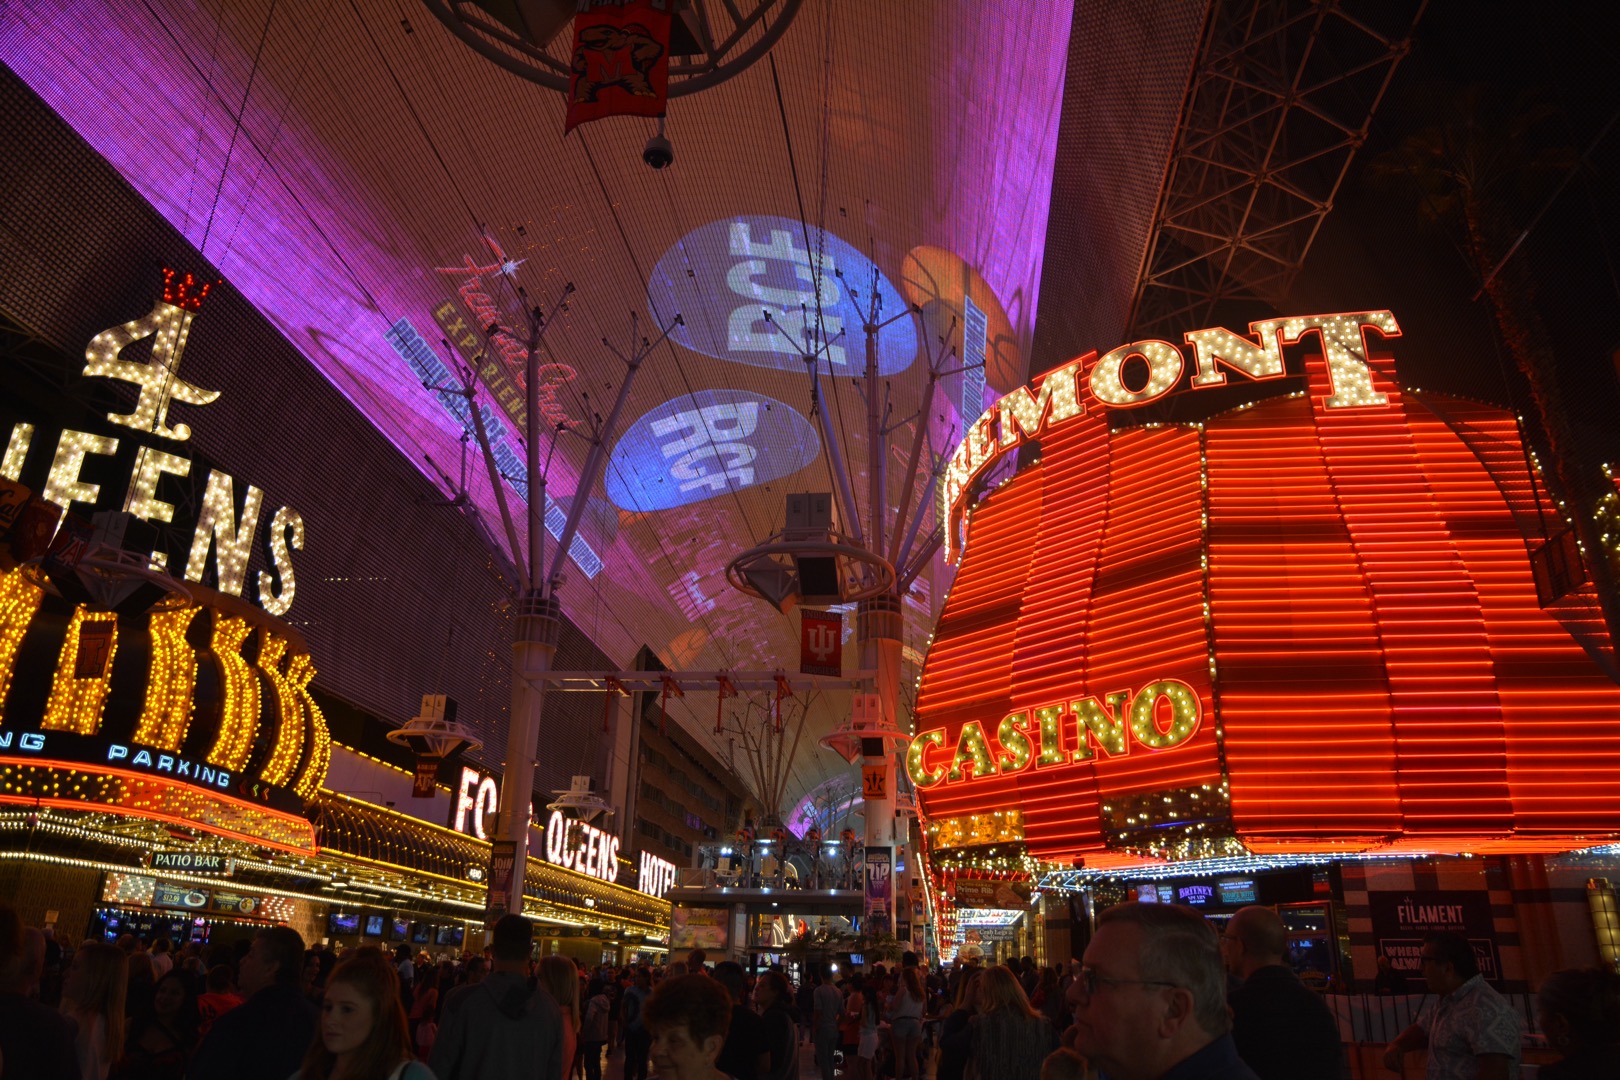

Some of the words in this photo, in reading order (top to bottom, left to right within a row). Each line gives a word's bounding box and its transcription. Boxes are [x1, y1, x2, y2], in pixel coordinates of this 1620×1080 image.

[436, 301, 530, 428] EXPERIENC
[906, 679, 1203, 789] CASINO
[107, 743, 231, 789] PARKING
[546, 809, 621, 884] QUEENS
[155, 853, 191, 868] PATIO
[194, 855, 220, 868] BAR
[493, 857, 515, 870] JOIN
[956, 885, 979, 894] Prime
[981, 886, 994, 895] Rib
[1179, 885, 1213, 899] BRITNEY
[1396, 904, 1465, 924] FILAMENT
